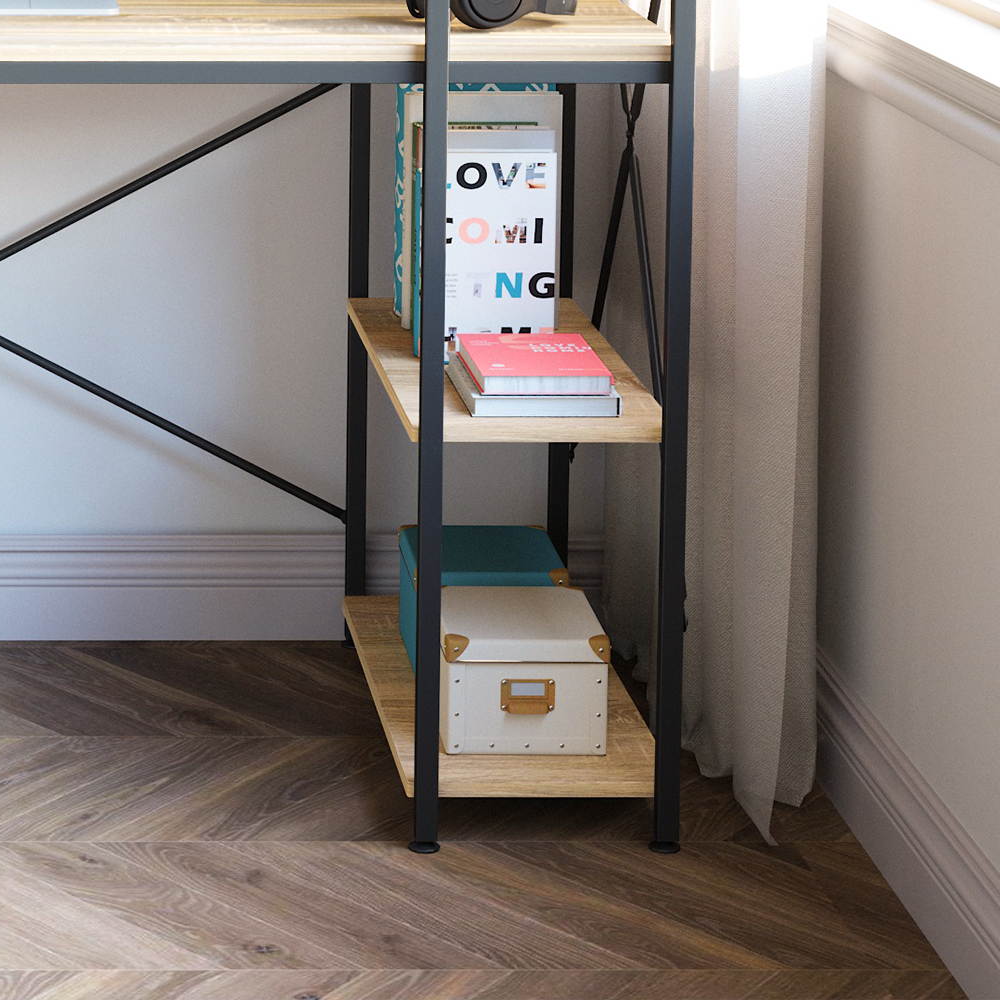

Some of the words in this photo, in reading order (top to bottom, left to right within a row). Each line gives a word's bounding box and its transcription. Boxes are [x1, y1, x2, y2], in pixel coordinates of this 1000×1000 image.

[447, 162, 548, 190] OVE
[446, 217, 544, 244] OMI
[495, 271, 556, 299] NG
